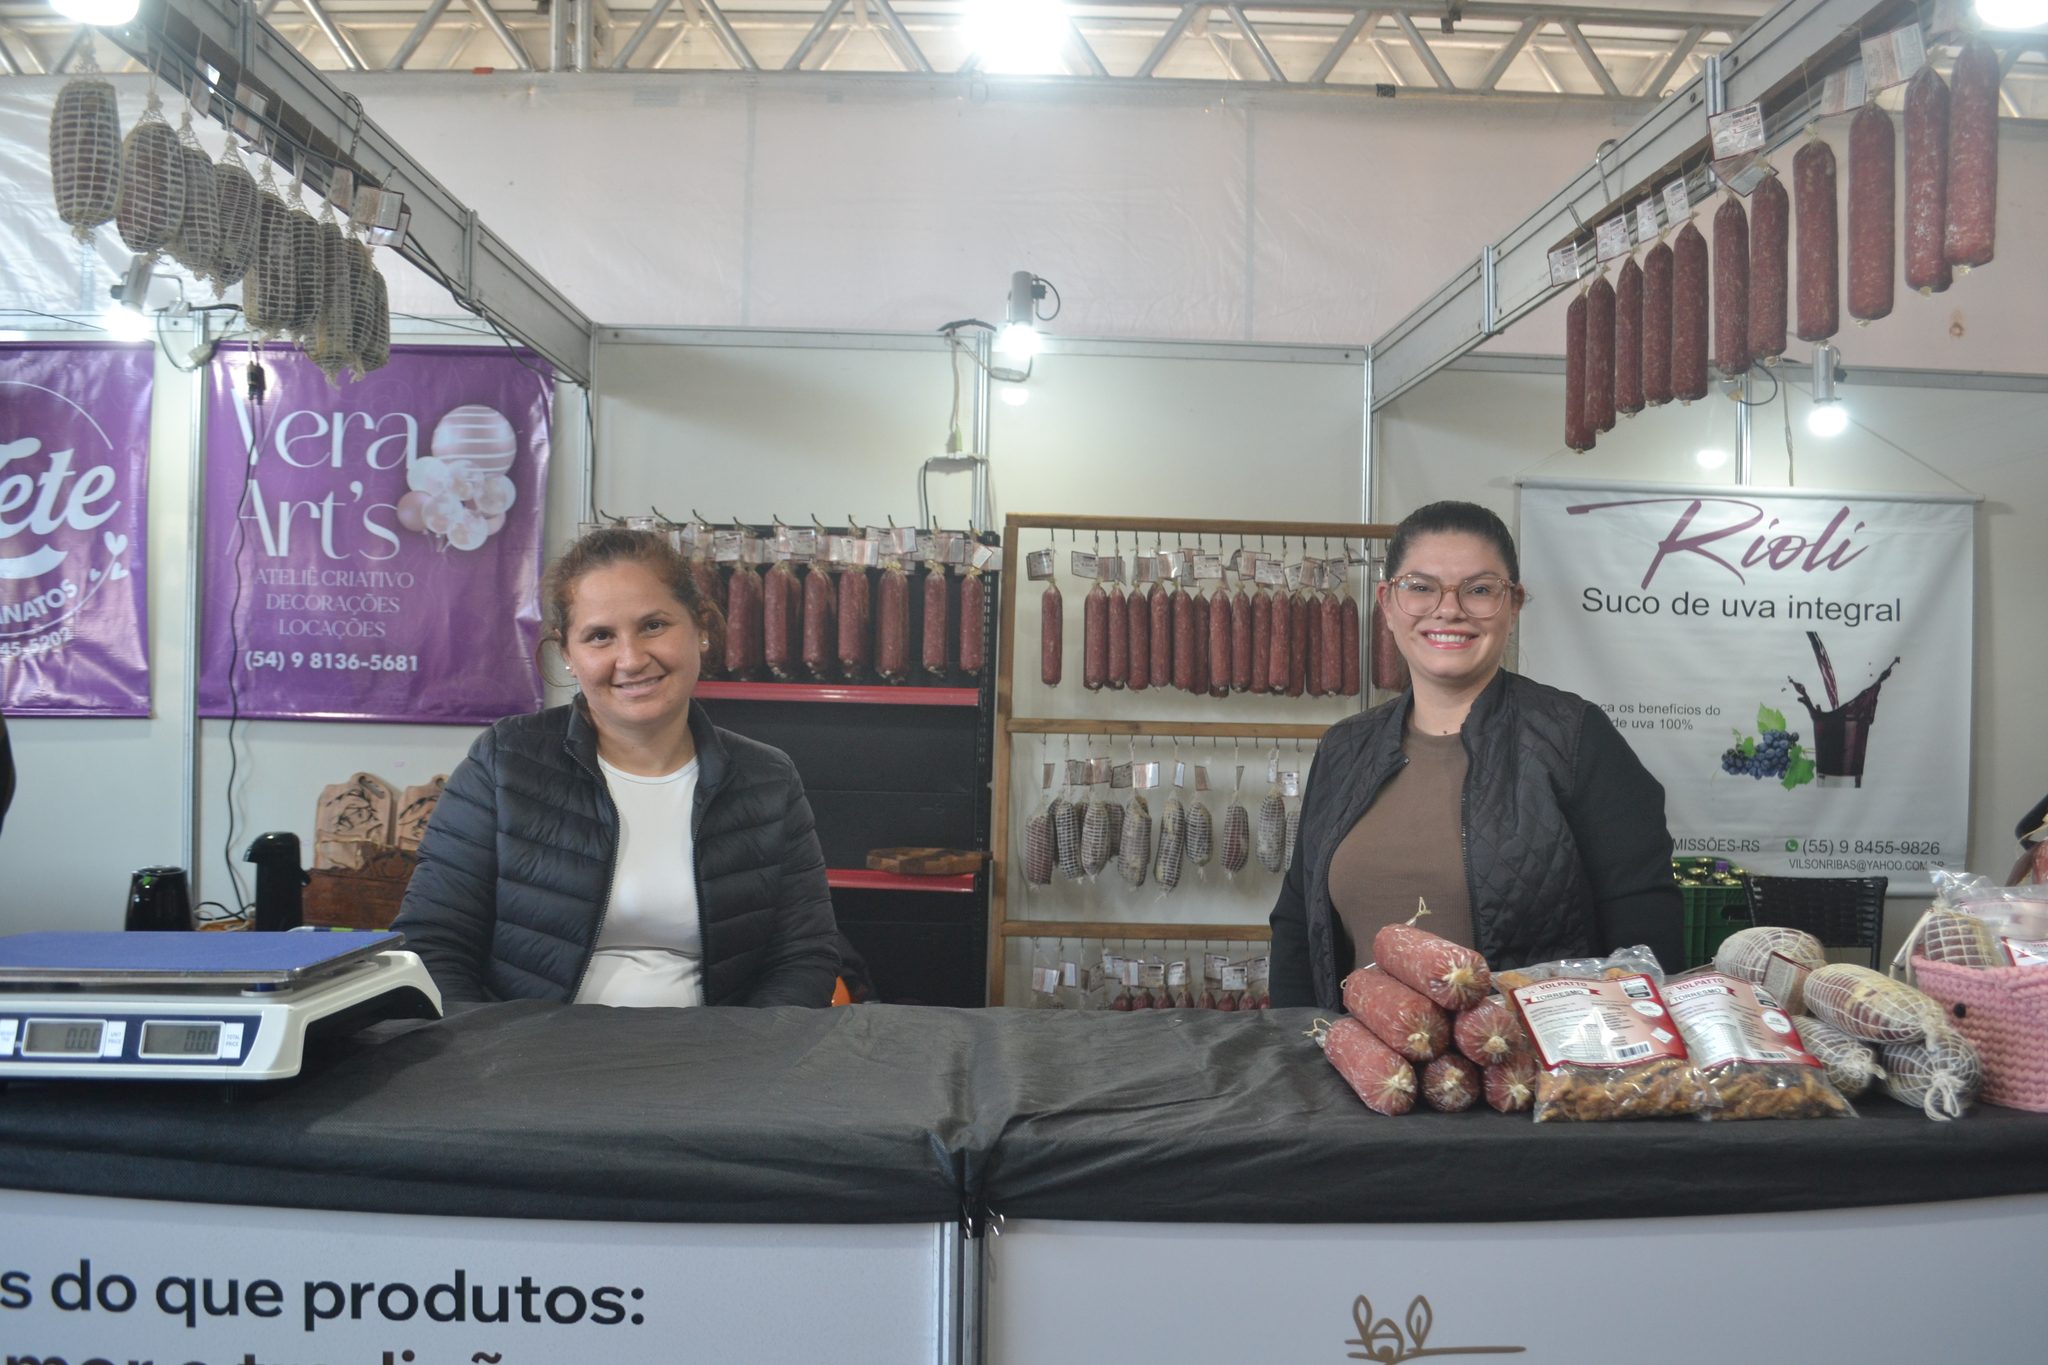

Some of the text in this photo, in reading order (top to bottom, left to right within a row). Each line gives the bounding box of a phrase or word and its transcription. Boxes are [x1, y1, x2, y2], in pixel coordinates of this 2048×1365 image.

[231, 386, 418, 470] Vera
[225, 479, 400, 560] Art's
[1566, 498, 1869, 590] Rioli
[254, 566, 415, 589] ATELIÊ CRIATIVO
[266, 593, 400, 615] DECORAÇÕES
[1582, 587, 1900, 627] Suco de uva integral
[279, 617, 386, 640] LOCAÇÕES
[245, 650, 418, 671] (54) 9 8136-5681
[1619, 704, 1634, 713] os
[1705, 704, 1721, 716] do
[1631, 719, 1655, 729] uva
[1660, 718, 1693, 730] 100%
[1673, 836, 1760, 852] MISSÕES-RS
[1802, 839, 1940, 856] (55) 9 8455-9826
[1789, 858, 1945, 872] VILSONRIBAS@YAHOO.COM
[51, 1258, 137, 1313] do
[155, 1275, 284, 1328] que
[304, 1269, 645, 1332] produtos:
